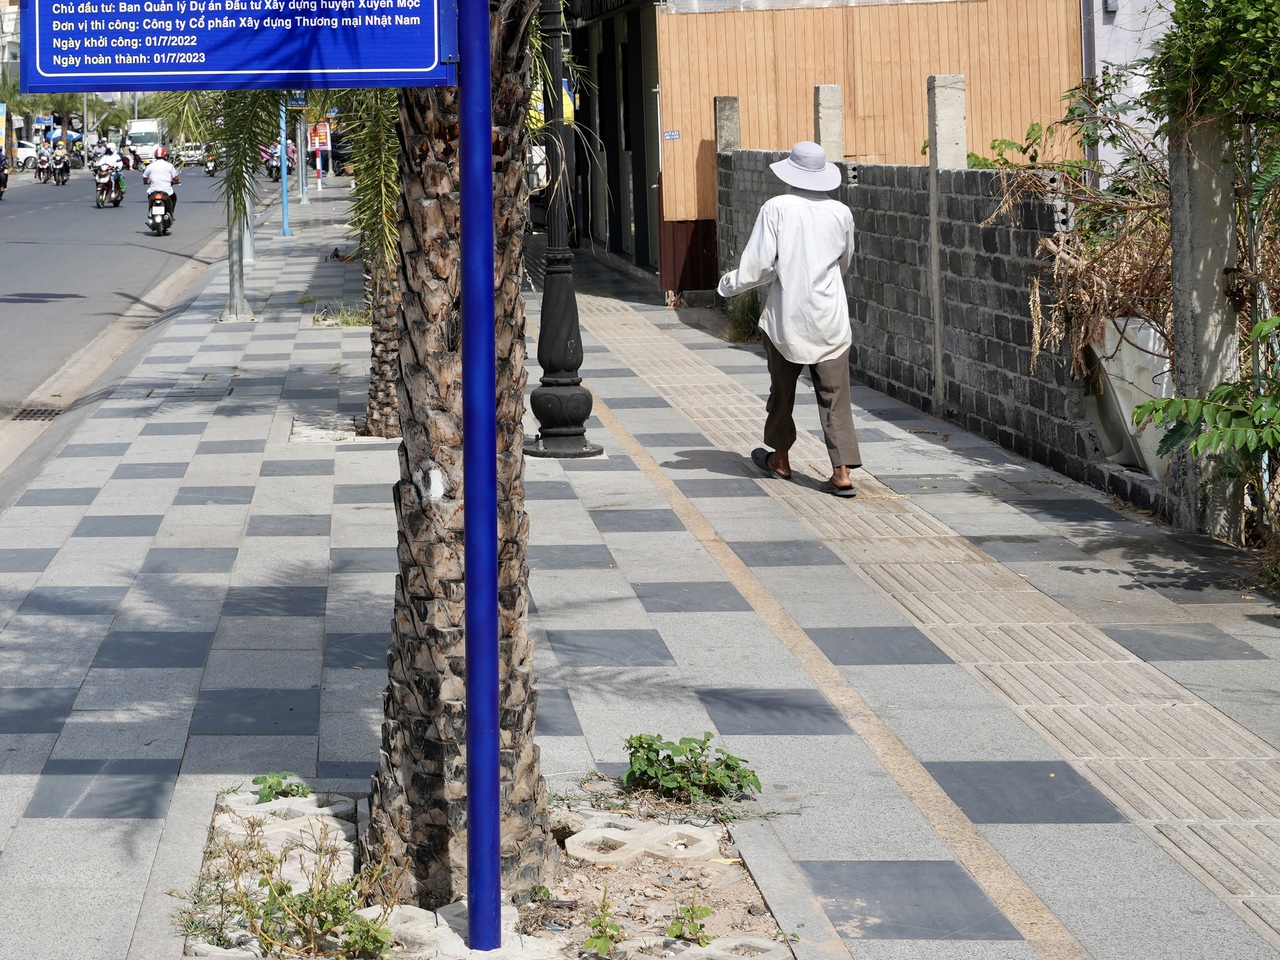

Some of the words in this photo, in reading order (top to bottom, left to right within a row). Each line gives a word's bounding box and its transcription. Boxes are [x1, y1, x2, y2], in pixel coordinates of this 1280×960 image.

[52, 2, 74, 14] Chủ
[77, 2, 97, 13] đầu
[100, 3, 114, 12] tư:
[119, 2, 139, 12] Ban
[143, 0, 172, 12] Quản
[176, 1, 185, 13] lý
[189, 1, 205, 13] Dự
[207, 0, 220, 10] án
[224, 0, 246, 10] Đầu
[249, 0, 261, 10] tư
[263, 0, 284, 12] Xây
[288, 0, 315, 11] dựng
[52, 21, 73, 31] Đơn
[77, 20, 87, 32] vị
[90, 20, 104, 30] thi
[108, 19, 138, 32] công:
[142, 19, 171, 31] Công
[174, 19, 185, 31] ty
[188, 15, 204, 28] Cổ
[207, 16, 234, 30] phần
[238, 17, 259, 29] Xây
[262, 17, 290, 29] dựng
[294, 17, 336, 28] Thương
[341, 16, 360, 27] mại
[364, 15, 390, 27] Nhật
[394, 15, 419, 25] Nam
[53, 38, 80, 50] Ngày
[84, 36, 106, 47] khởi
[110, 37, 140, 49] công:
[144, 36, 196, 46] 01/7/2022
[53, 55, 80, 67] Ngày
[84, 54, 111, 64] hoàn
[114, 53, 149, 64] thành:
[153, 53, 205, 63] 01/7/2023
